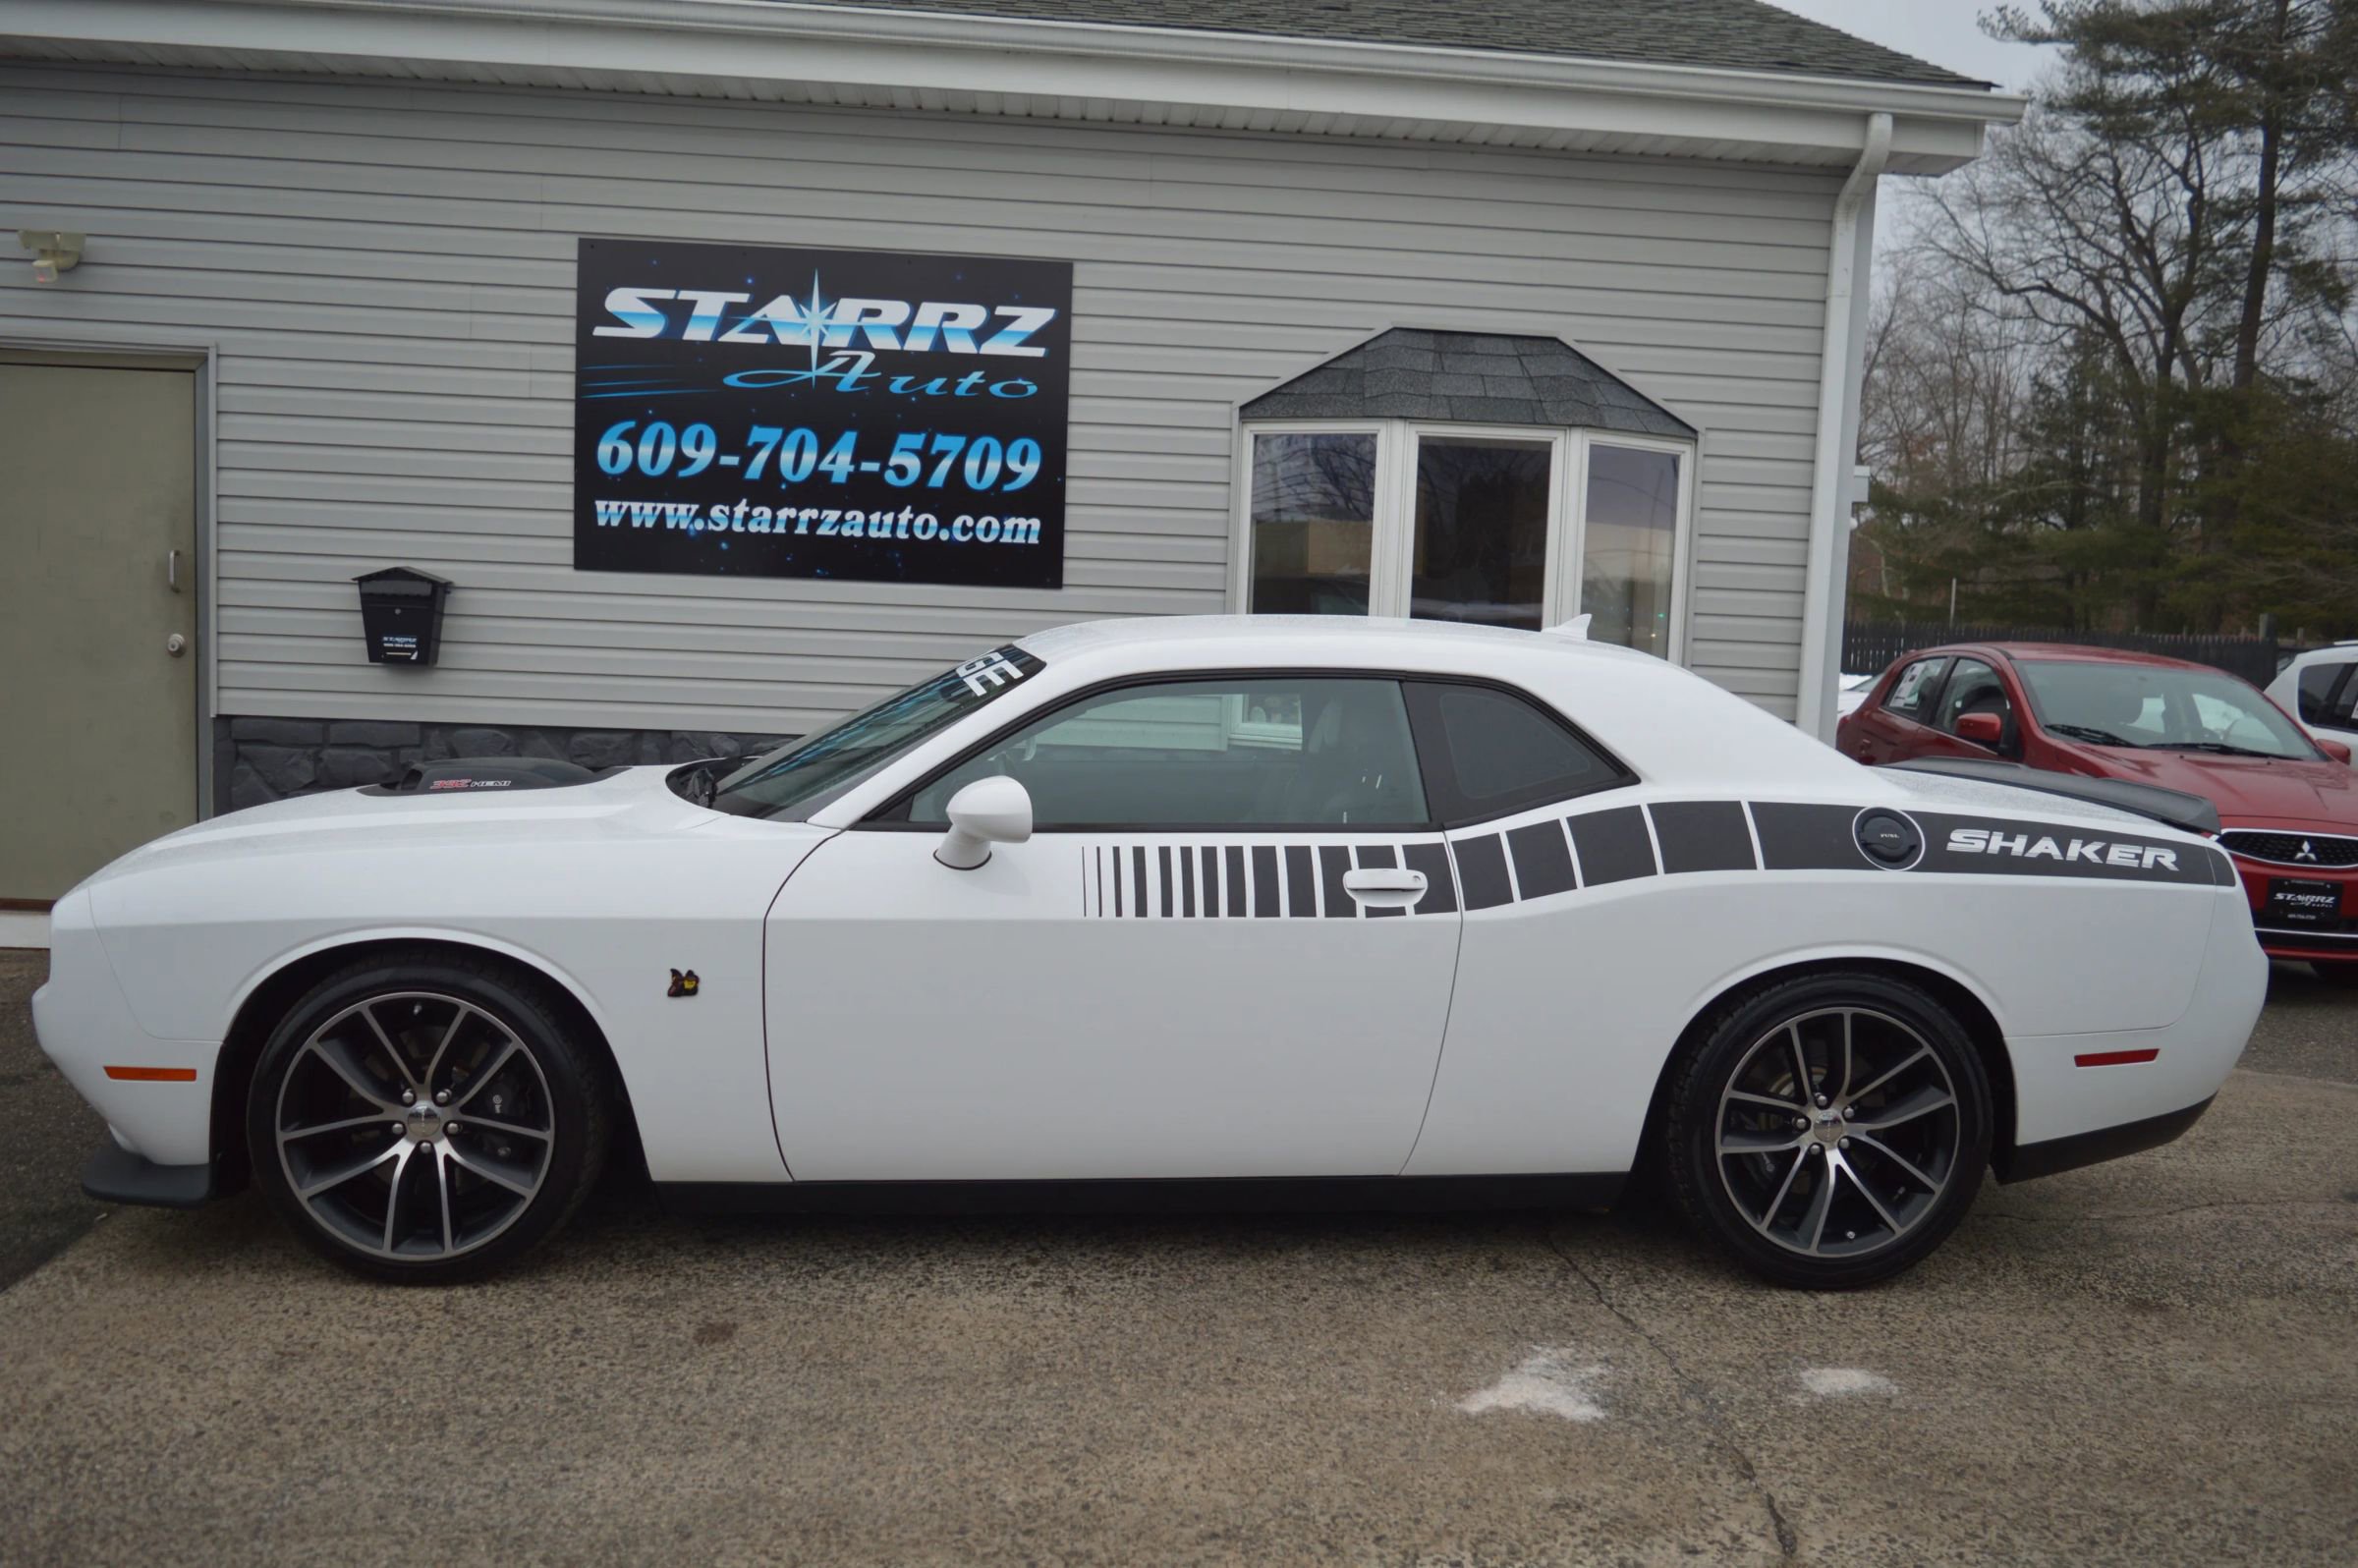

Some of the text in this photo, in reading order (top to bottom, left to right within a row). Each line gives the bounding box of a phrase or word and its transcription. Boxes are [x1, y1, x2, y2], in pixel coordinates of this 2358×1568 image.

[592, 286, 1058, 357] STARRZ
[723, 351, 1039, 398] Auto
[596, 420, 1041, 491] 609-704-5709
[594, 498, 1041, 544] www.starrzauto.com
[1946, 828, 2180, 871] SHAKER
[2274, 892, 2335, 904] STARRZ
